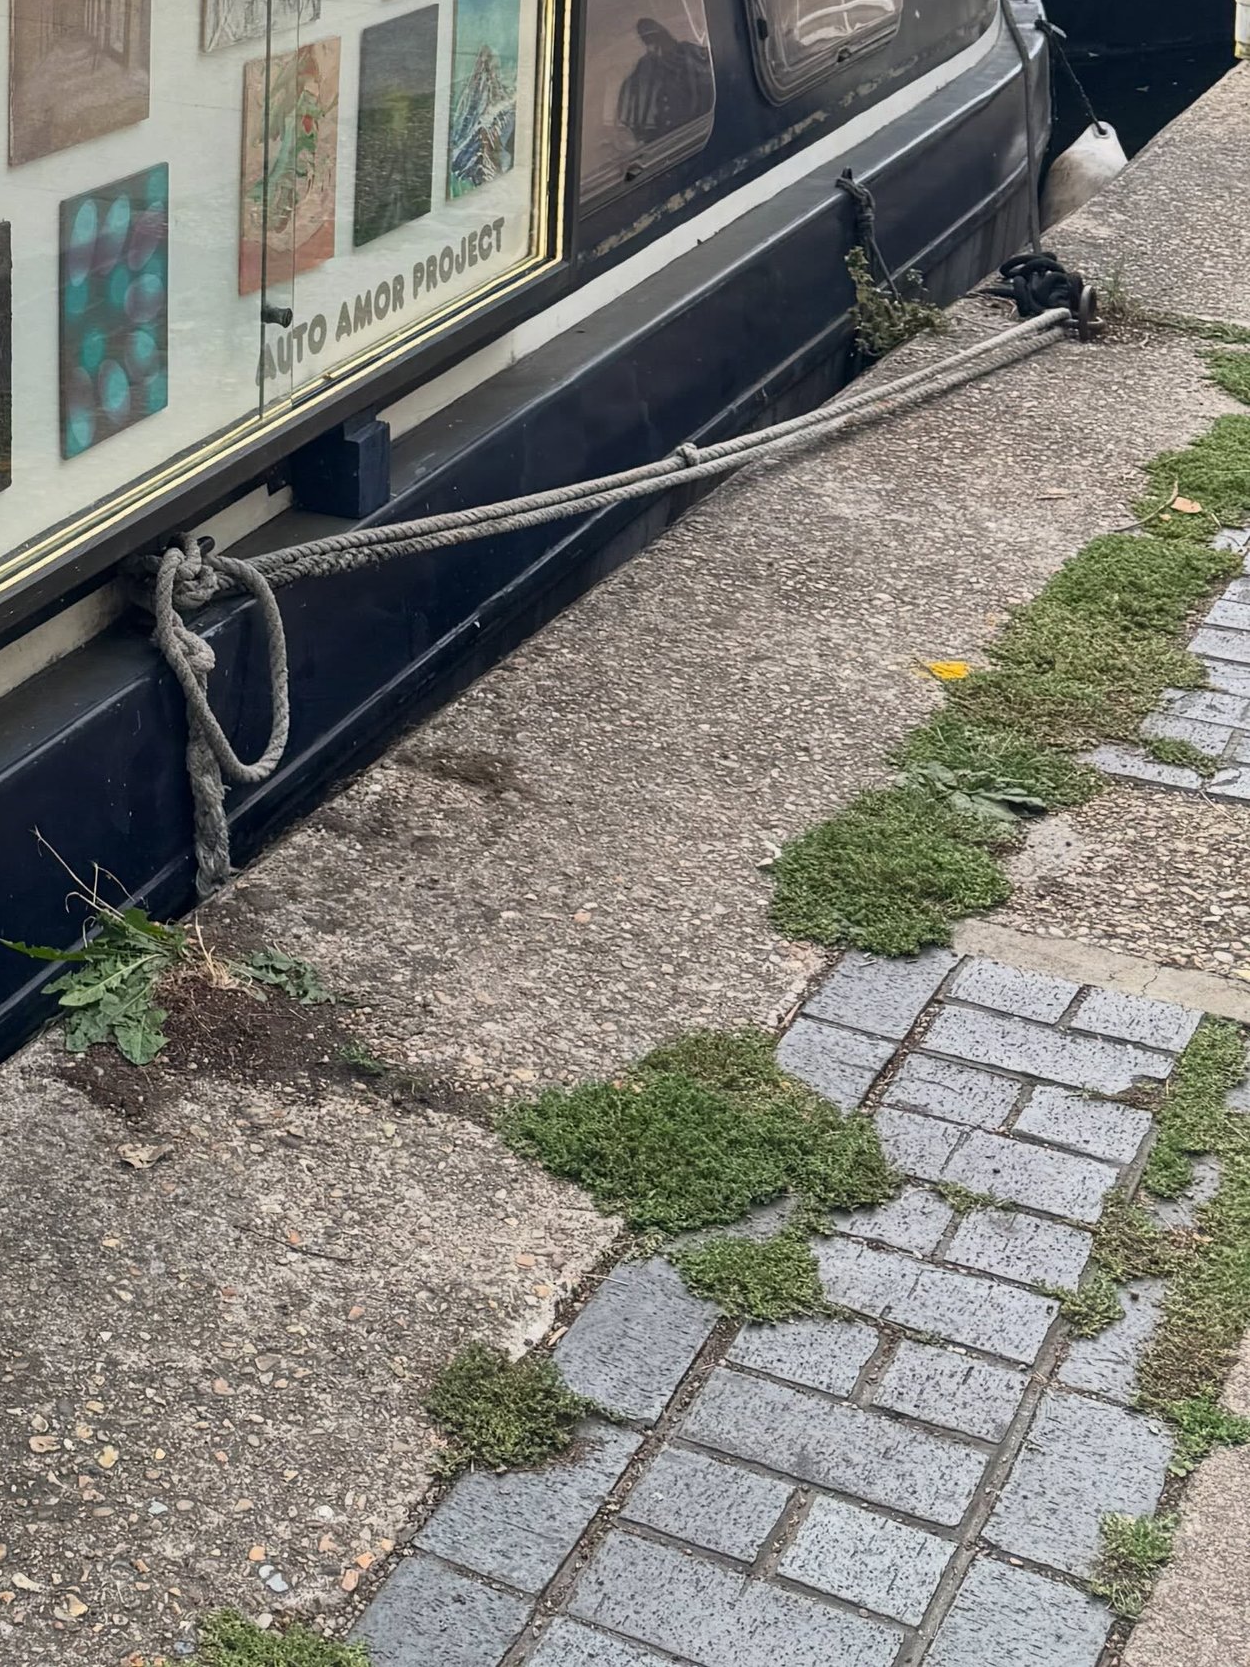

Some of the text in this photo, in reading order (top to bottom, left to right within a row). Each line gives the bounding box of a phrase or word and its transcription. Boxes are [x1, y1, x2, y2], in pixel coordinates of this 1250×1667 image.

[255, 217, 505, 386] AUTO AMOR PROJECT
